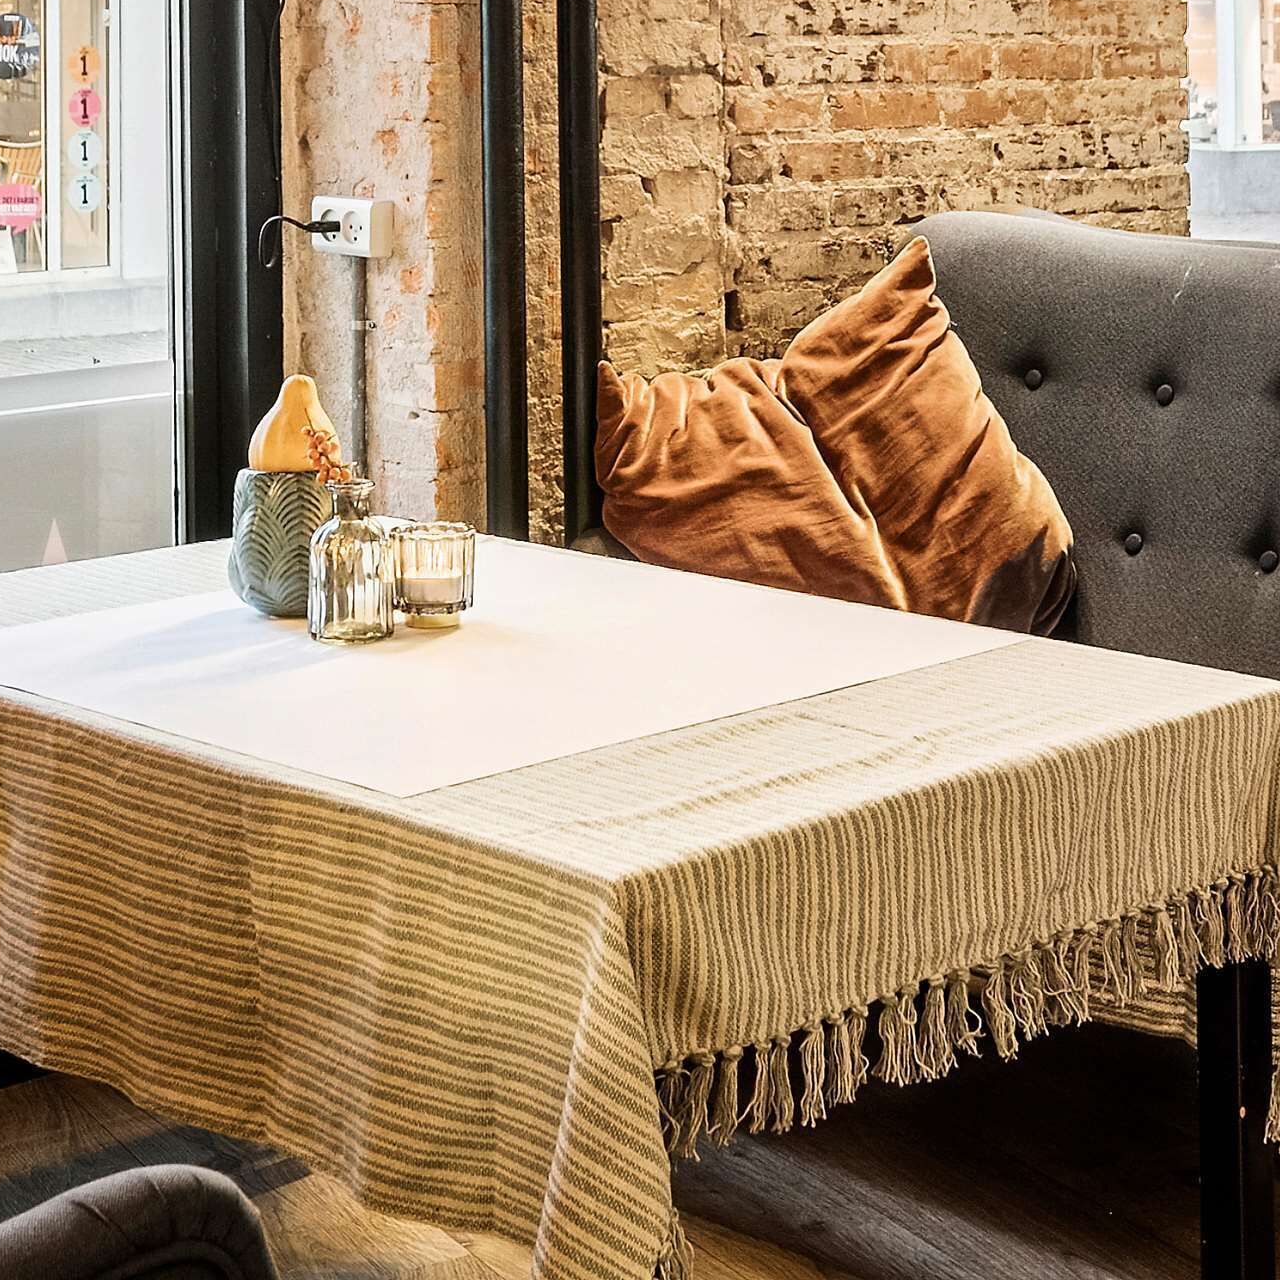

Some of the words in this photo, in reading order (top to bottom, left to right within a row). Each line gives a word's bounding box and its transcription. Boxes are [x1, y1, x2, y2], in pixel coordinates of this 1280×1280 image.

[80, 55, 88, 76] 1
[80, 98, 89, 119] 1
[80, 140, 89, 161] 1
[80, 184, 89, 204] 1
